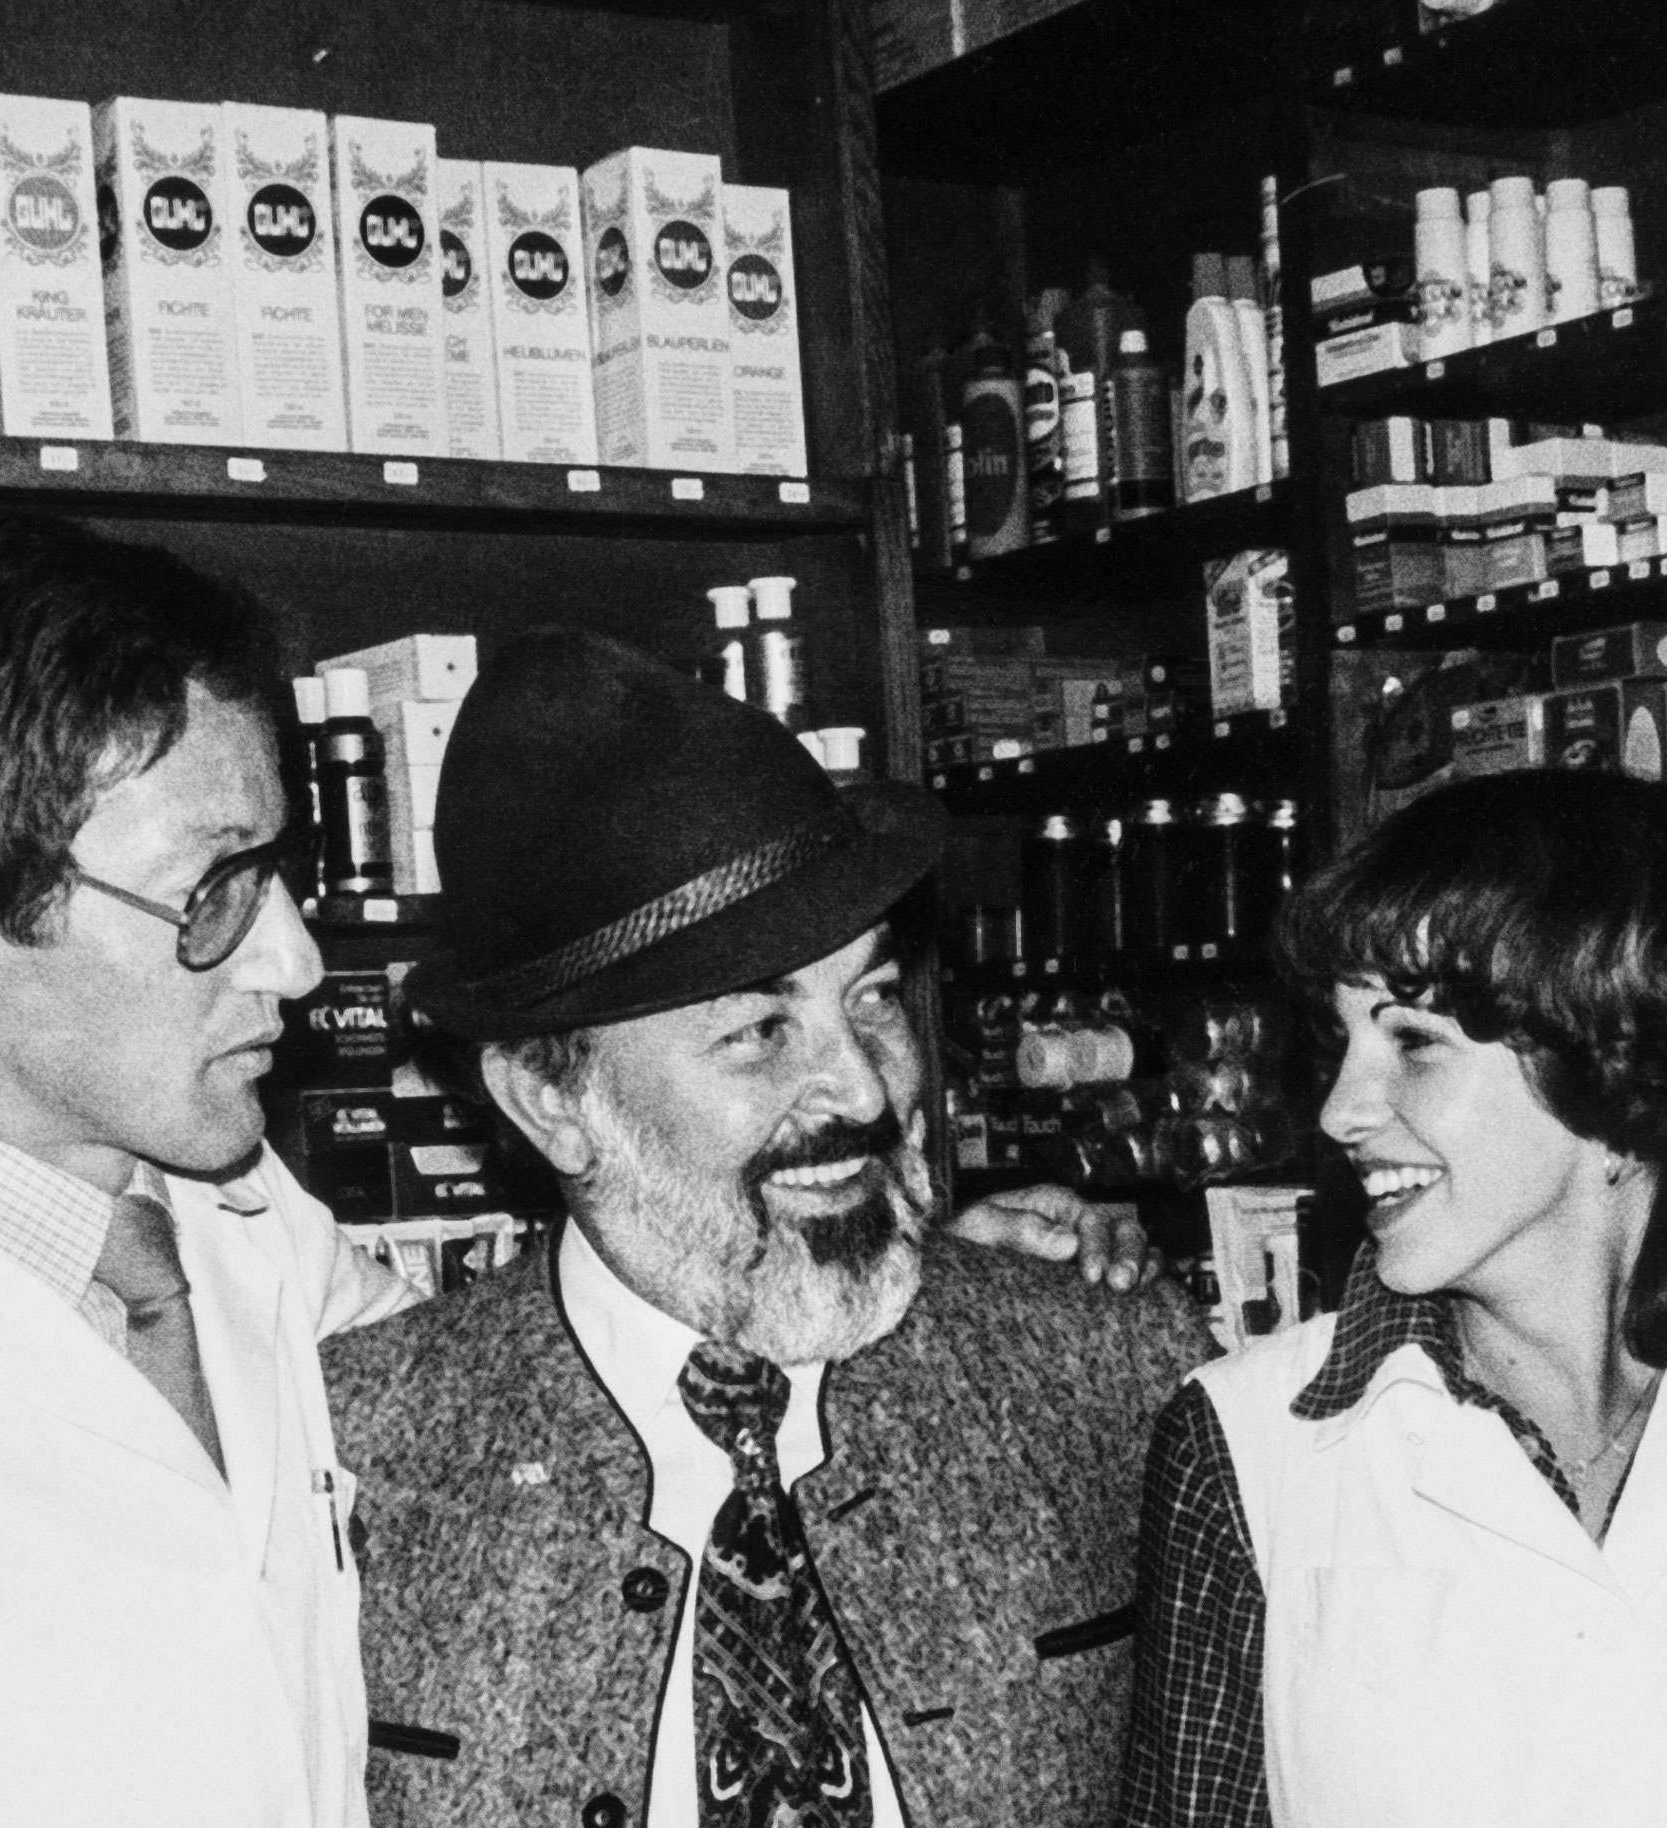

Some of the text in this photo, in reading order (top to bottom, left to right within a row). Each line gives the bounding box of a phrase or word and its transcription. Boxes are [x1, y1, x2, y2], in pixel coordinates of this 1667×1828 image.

[158, 300, 210, 318] FICHTE
[261, 305, 314, 323] FICHTE
[502, 344, 587, 363] HEUBLUMEN
